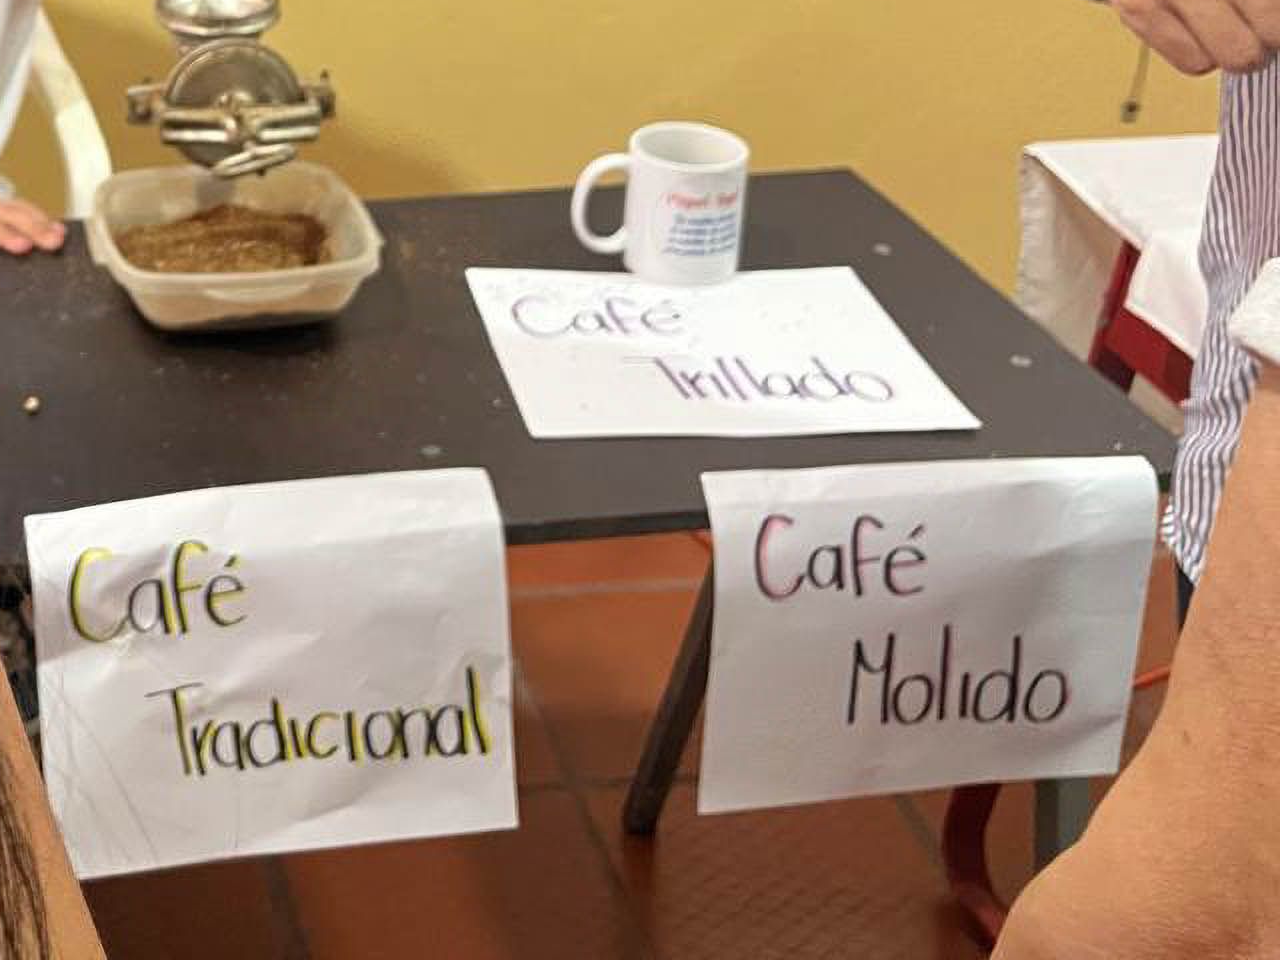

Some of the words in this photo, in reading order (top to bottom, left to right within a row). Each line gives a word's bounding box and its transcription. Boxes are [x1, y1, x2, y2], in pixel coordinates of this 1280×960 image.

[510, 292, 683, 339] Café
[623, 354, 894, 402] Trillado
[70, 540, 246, 642] Café
[754, 514, 928, 601] Café
[144, 665, 492, 777] Tradicional
[847, 624, 1072, 726] Molido
